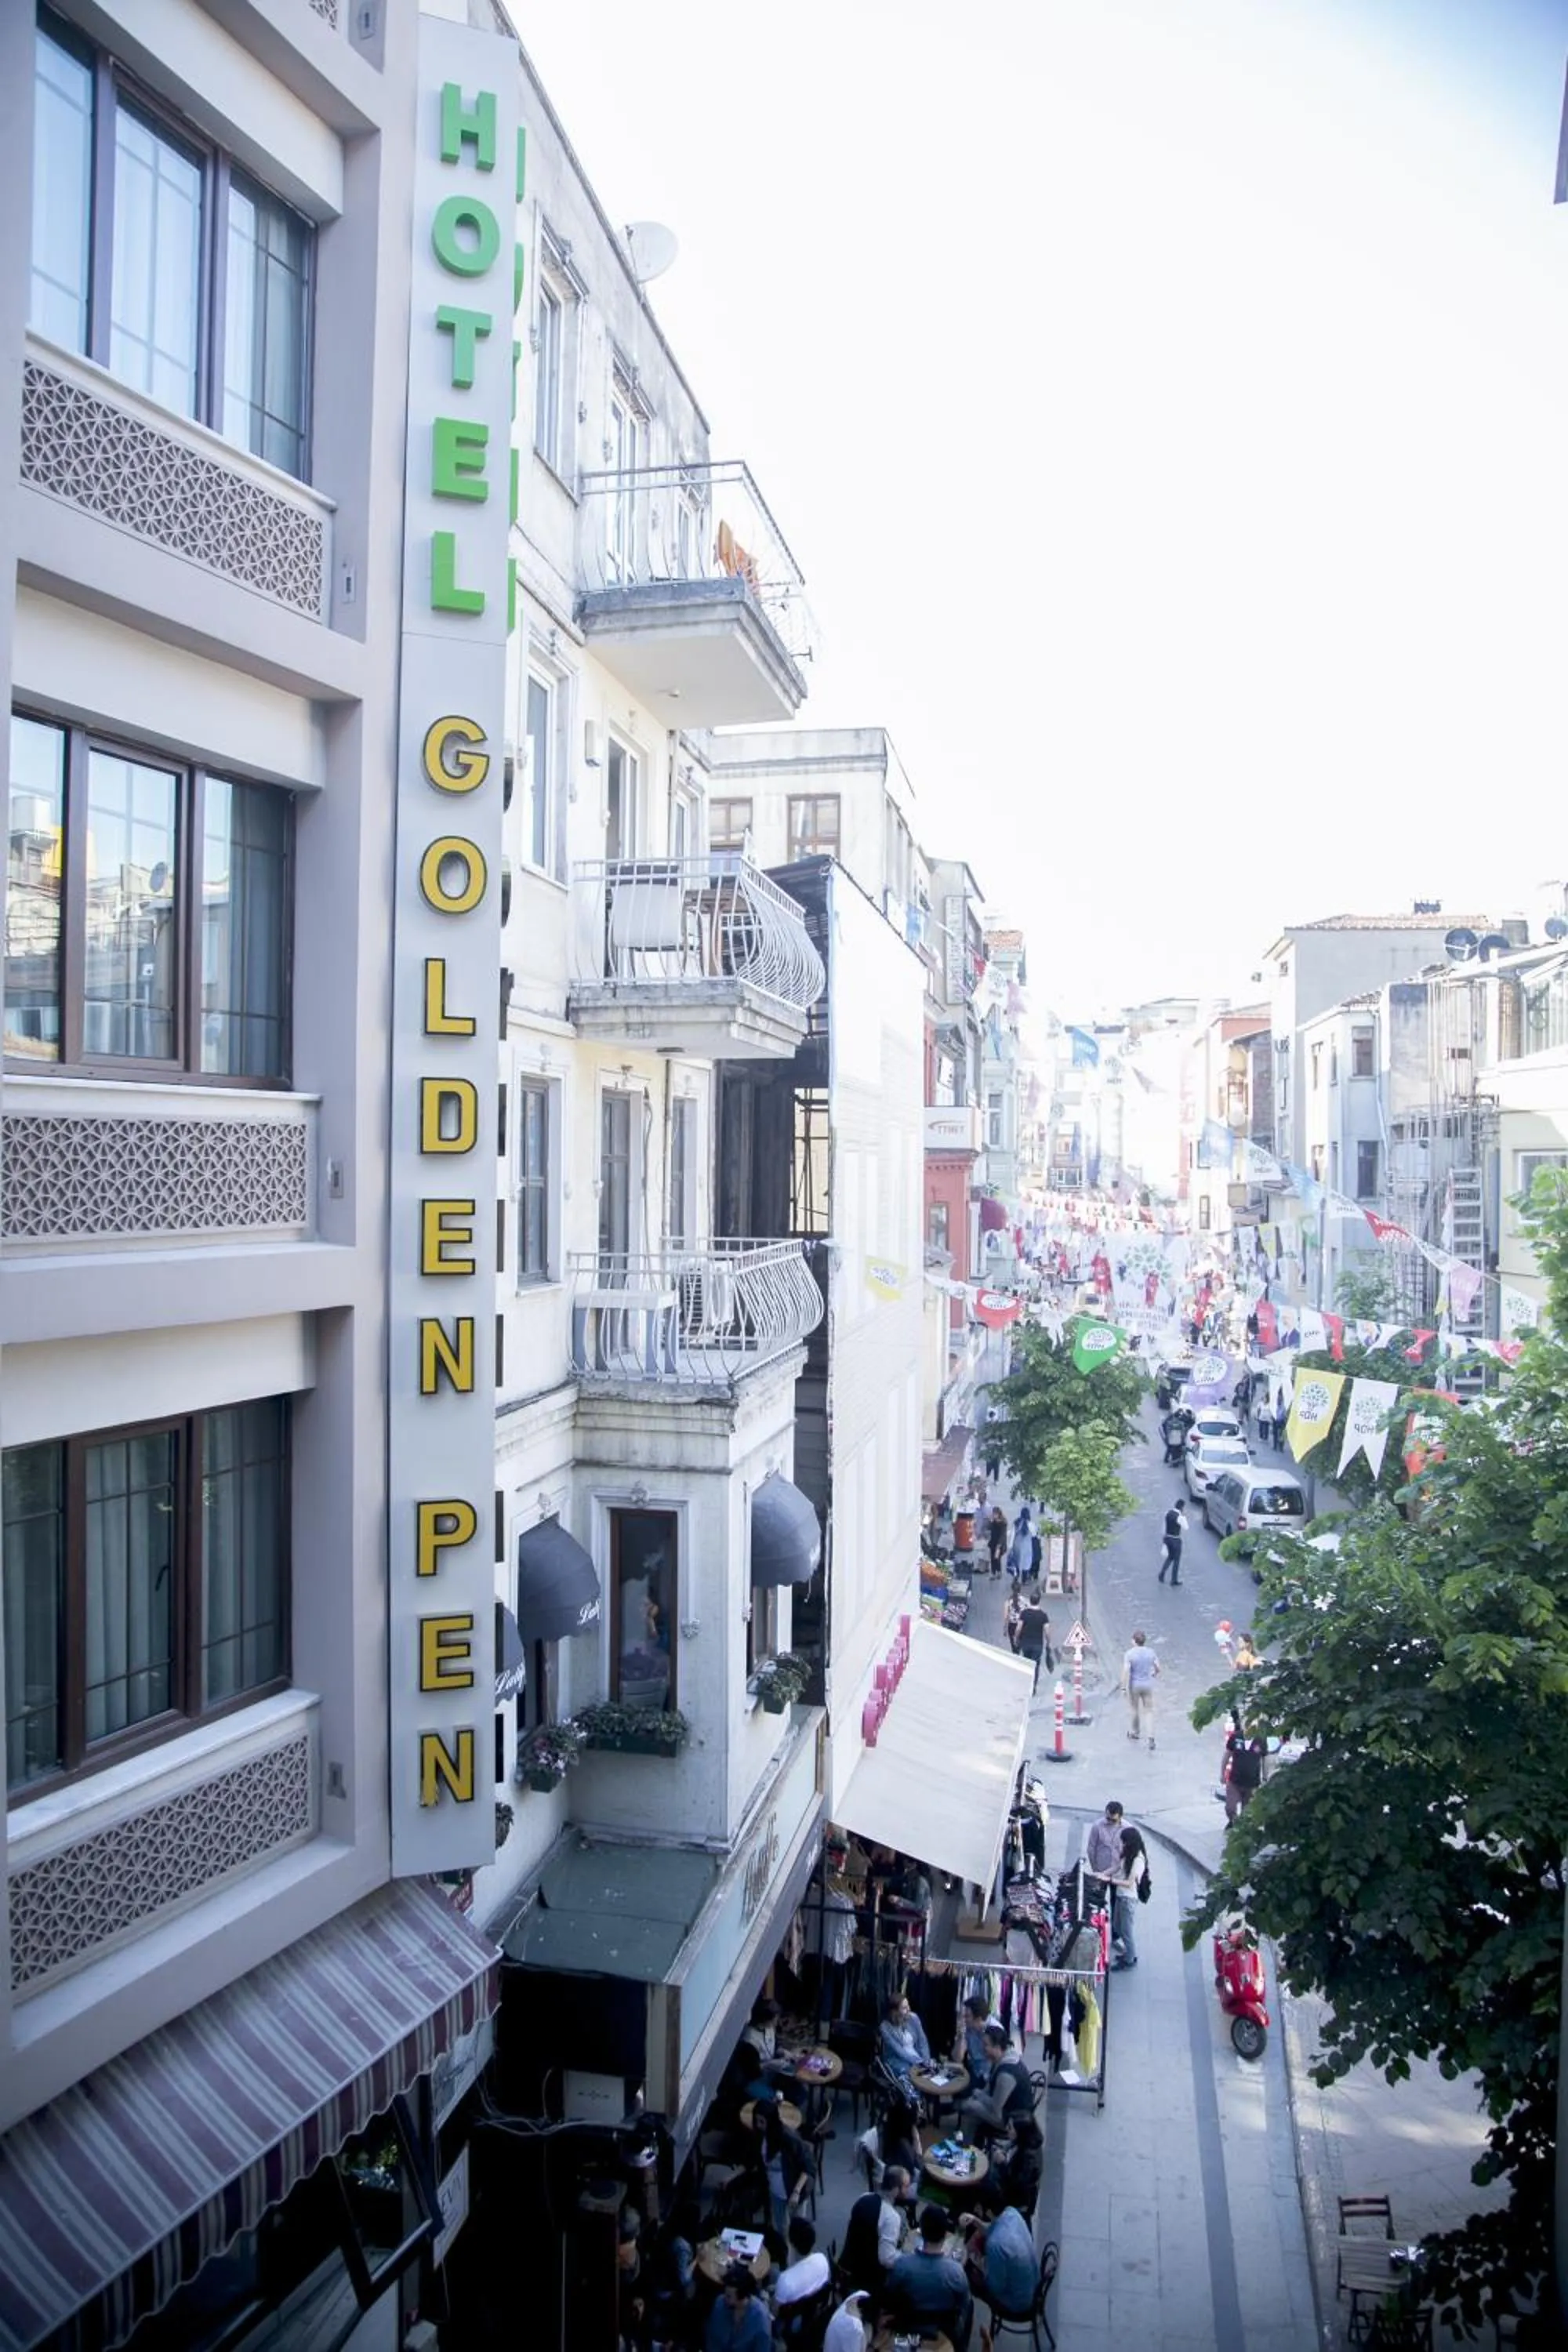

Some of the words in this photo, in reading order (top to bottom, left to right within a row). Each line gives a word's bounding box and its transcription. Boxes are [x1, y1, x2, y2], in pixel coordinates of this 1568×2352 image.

[431, 82, 500, 615] HOTEL
[419, 714, 490, 1396] GOLDEN
[416, 1498, 477, 1807] PEN
